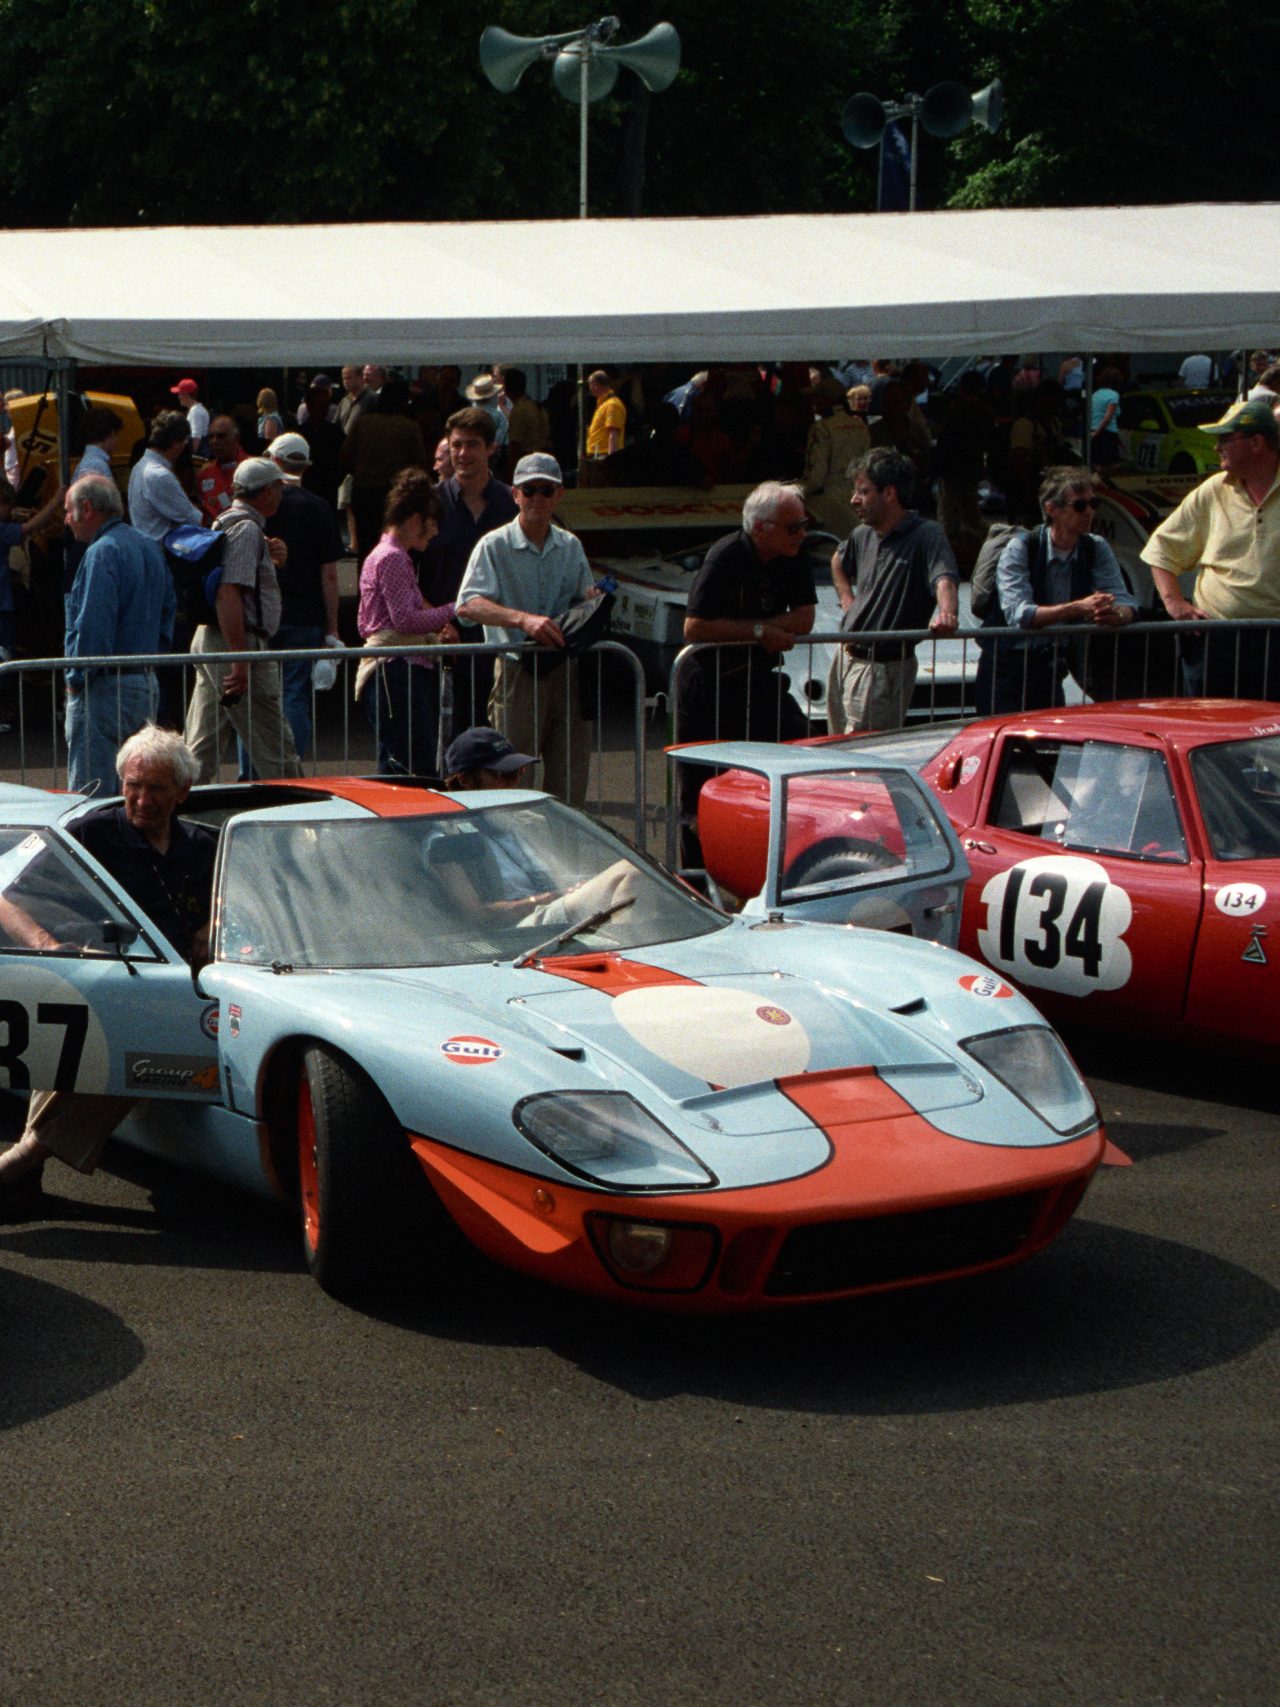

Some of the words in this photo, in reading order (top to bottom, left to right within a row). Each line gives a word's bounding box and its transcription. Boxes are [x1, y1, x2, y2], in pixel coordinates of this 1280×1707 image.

[1223, 892, 1257, 909] 134
[999, 867, 1108, 978] 134
[973, 976, 997, 997] Gulf
[441, 1042, 501, 1057] Gulf
[131, 1059, 195, 1080] Group
[191, 1064, 219, 1090] 4
